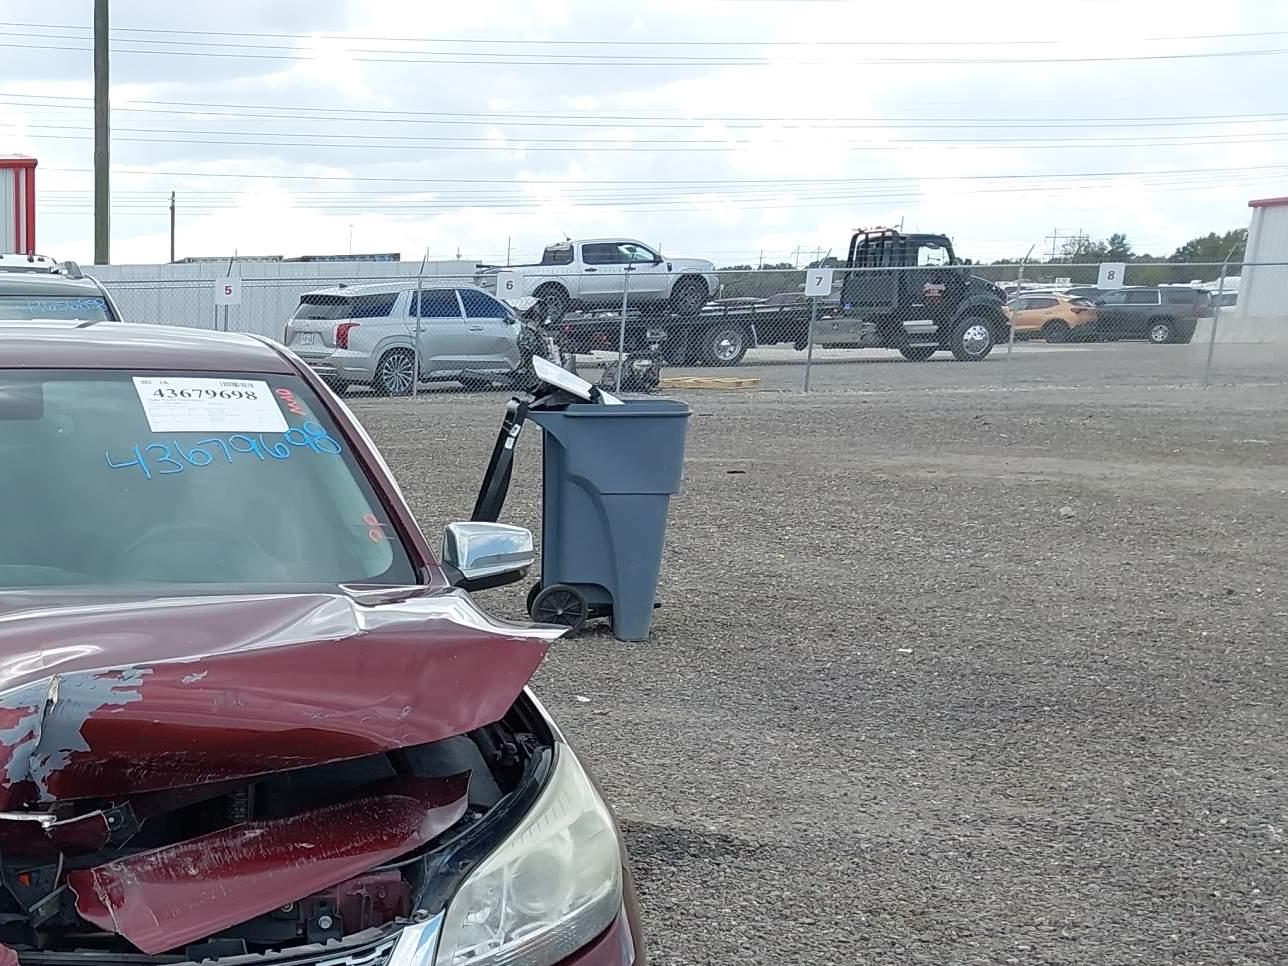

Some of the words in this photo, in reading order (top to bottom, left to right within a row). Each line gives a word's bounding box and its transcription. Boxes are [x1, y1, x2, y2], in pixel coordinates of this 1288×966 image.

[1107, 270, 1115, 281] 8
[505, 280, 514, 290] 6
[815, 276, 823, 287] 7
[224, 285, 233, 296] 5
[153, 388, 258, 401] 43679698
[105, 421, 342, 480] 43679698
